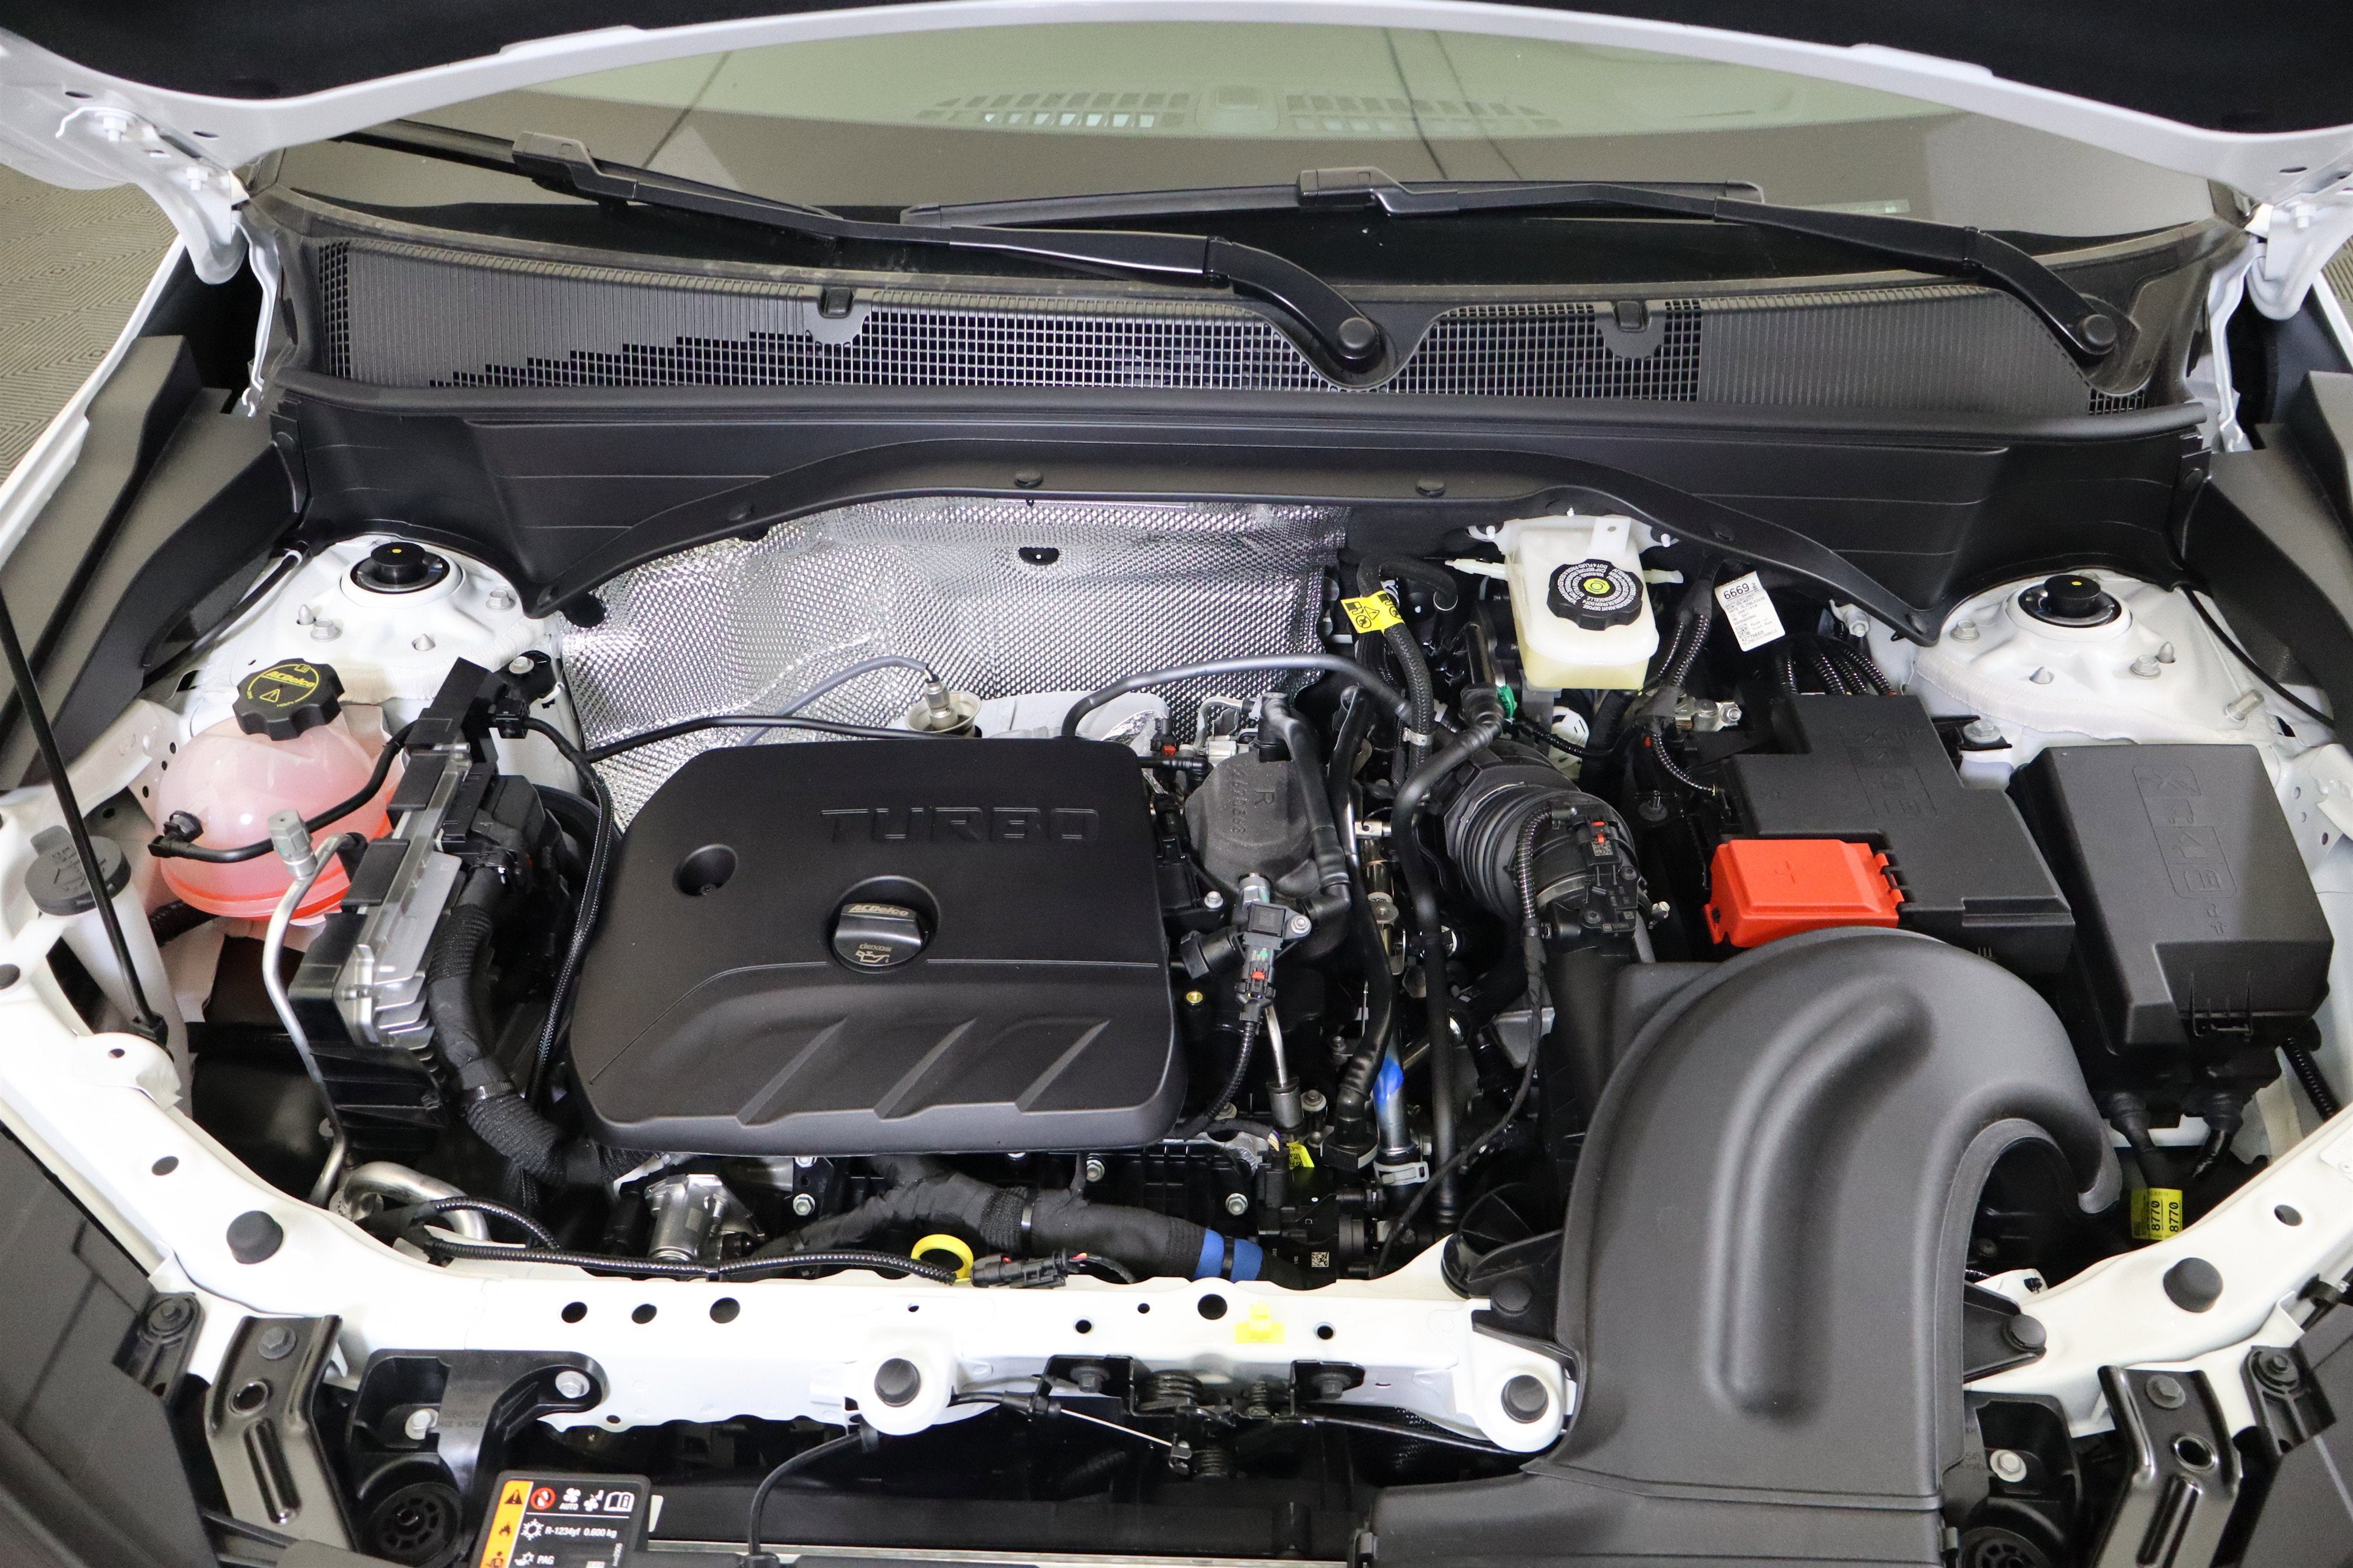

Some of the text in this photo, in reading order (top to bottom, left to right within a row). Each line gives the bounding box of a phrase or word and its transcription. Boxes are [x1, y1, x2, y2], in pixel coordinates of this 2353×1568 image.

[1564, 565, 1579, 573] FROM
[1557, 573, 1567, 586] SEALED
[1724, 584, 1749, 598] 6669
[265, 671, 315, 687] ACDelco
[1255, 790, 1275, 805] R
[820, 807, 1098, 843] TURBO
[848, 905, 909, 916] ACDelco
[859, 943, 892, 952] dexos
[2151, 1200, 2161, 1231] 8770
[2169, 1202, 2179, 1232] 8770
[545, 1526, 618, 1539] R-1234yf 0.600 kg
[537, 1555, 556, 1565] PAG
